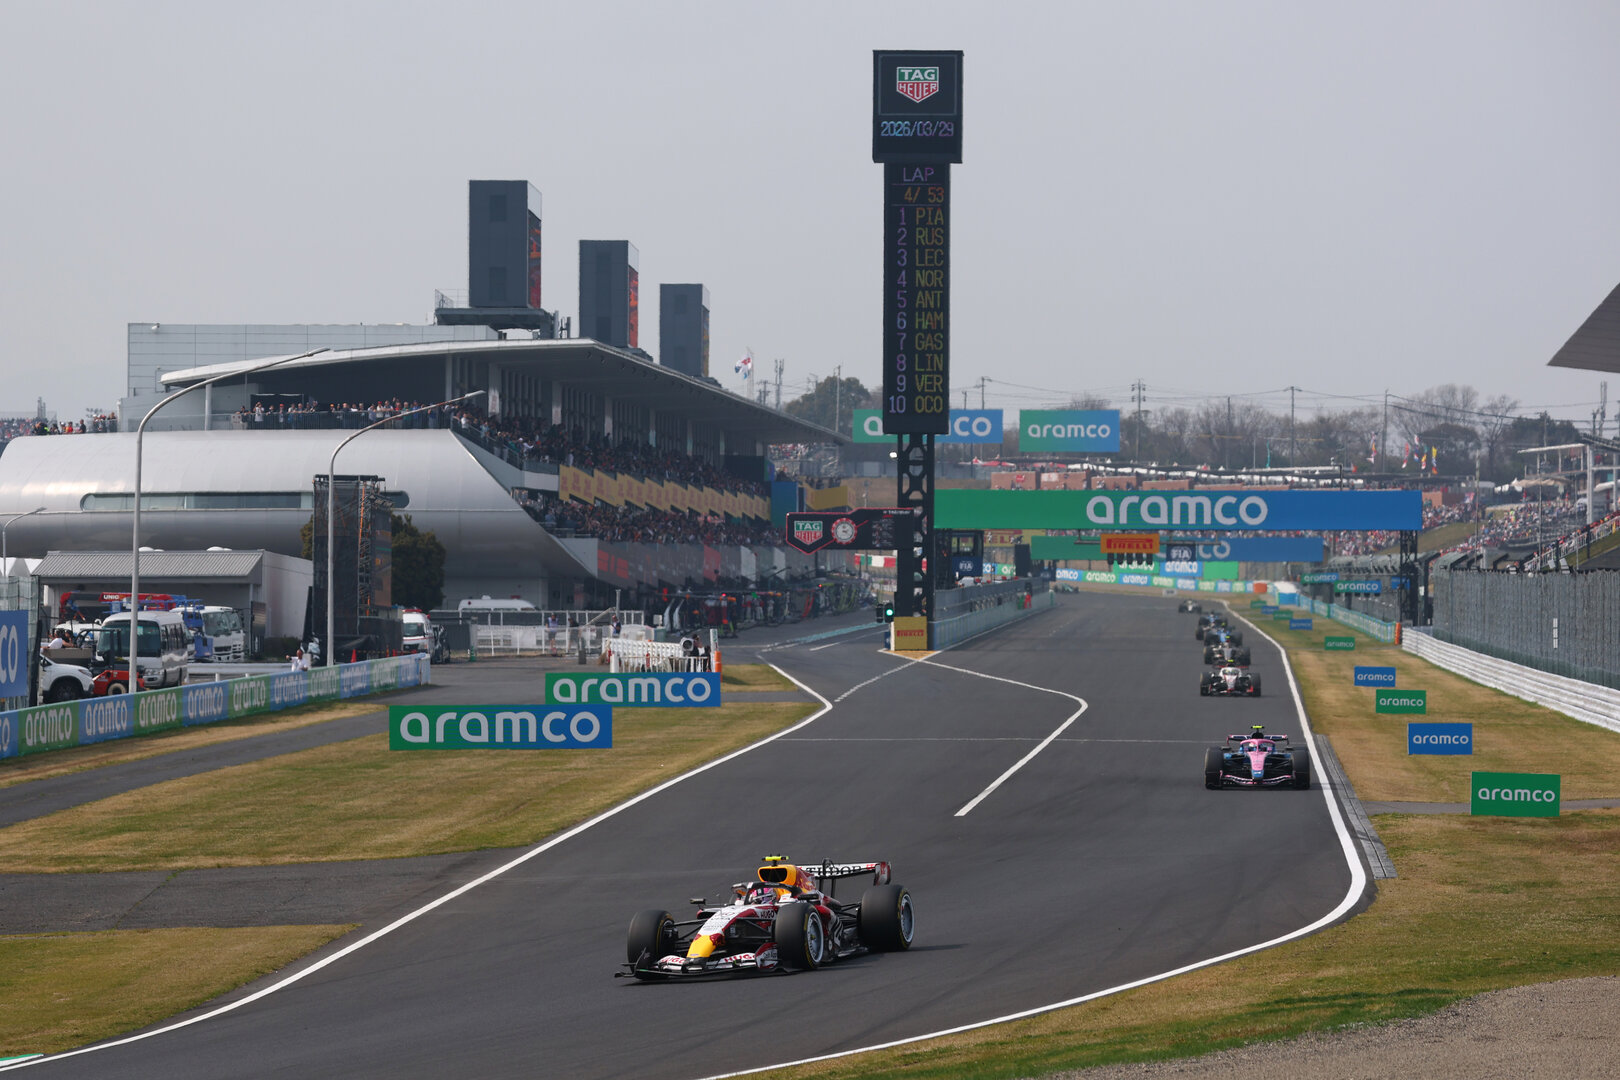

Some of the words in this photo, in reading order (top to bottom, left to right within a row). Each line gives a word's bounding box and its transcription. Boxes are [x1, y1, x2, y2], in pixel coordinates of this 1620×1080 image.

[900, 69, 936, 80] TAG
[899, 82, 936, 100] HEUER
[880, 121, 954, 136] 2026/03/29
[903, 168, 934, 182] LAP
[904, 186, 920, 203] 4/
[928, 187, 944, 203] 53
[900, 208, 906, 225] 1
[915, 208, 944, 225] PIA
[897, 228, 907, 246] 2
[915, 228, 944, 246] RUS
[897, 249, 907, 267] 3
[915, 249, 944, 267] LEC
[897, 270, 907, 287] 4
[915, 270, 944, 287] NOR
[897, 290, 906, 308] 5
[915, 290, 944, 308] ANT
[896, 312, 906, 329] 6
[915, 312, 944, 329] HAM
[897, 332, 906, 350] 7
[915, 332, 944, 350] GAS
[896, 353, 906, 371] 8
[915, 353, 944, 371] LIN
[896, 374, 906, 392] 9
[915, 374, 944, 392] VER
[888, 395, 906, 413] 10
[915, 395, 943, 413] OCO
[1027, 424, 1111, 438] aramco
[1086, 496, 1268, 526] aramco
[798, 522, 820, 530] TAG
[1170, 548, 1191, 560] FIA
[1056, 570, 1078, 579] amco
[1086, 572, 1116, 583] aramco
[1357, 673, 1394, 682] aramco
[233, 680, 266, 711] aramco
[553, 677, 711, 702] aramco
[139, 692, 176, 727] aramco
[188, 687, 223, 719] aramco
[1379, 698, 1424, 707] aramco
[26, 706, 72, 746] aramco
[85, 700, 128, 736] aramco
[400, 711, 600, 743] aramco
[1413, 734, 1469, 745] aramco
[1478, 788, 1555, 802] aramco
[761, 910, 774, 919] HUGO
